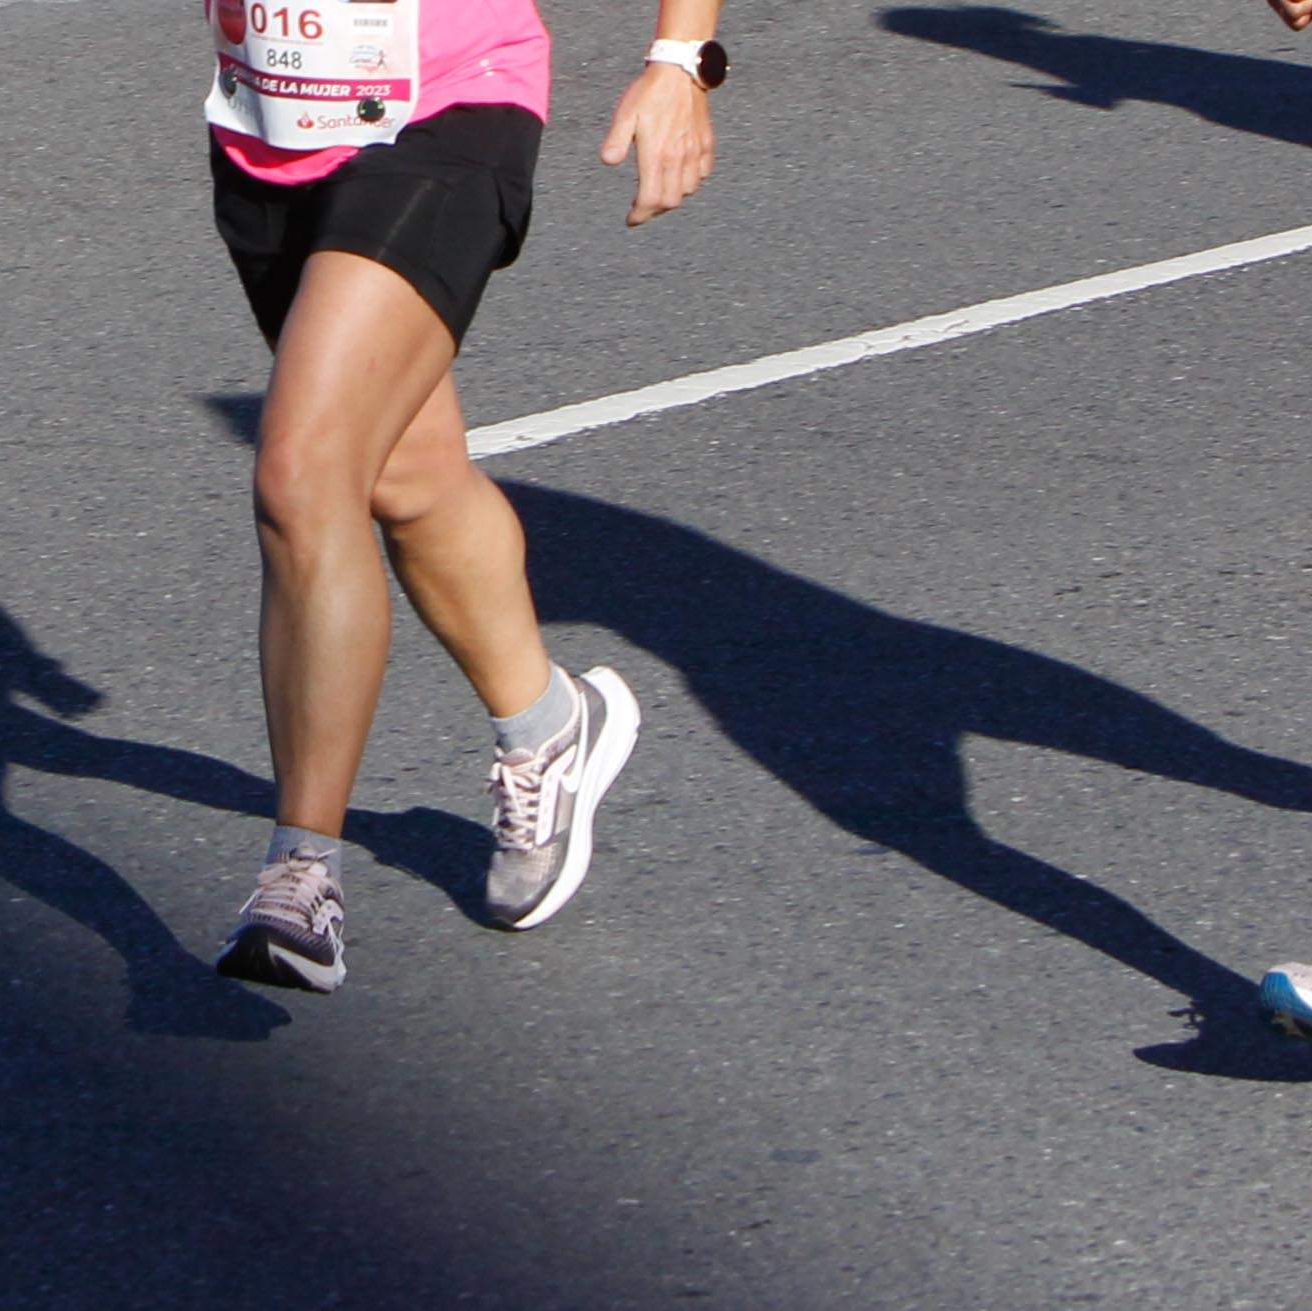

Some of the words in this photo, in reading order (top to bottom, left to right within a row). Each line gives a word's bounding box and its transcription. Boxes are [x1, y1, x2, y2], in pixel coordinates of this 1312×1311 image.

[250, 2, 323, 39] 016
[266, 48, 302, 70] 848
[261, 78, 279, 92] DE
[280, 80, 299, 94] LA
[300, 82, 351, 97] MUJER
[356, 84, 392, 97] 2023
